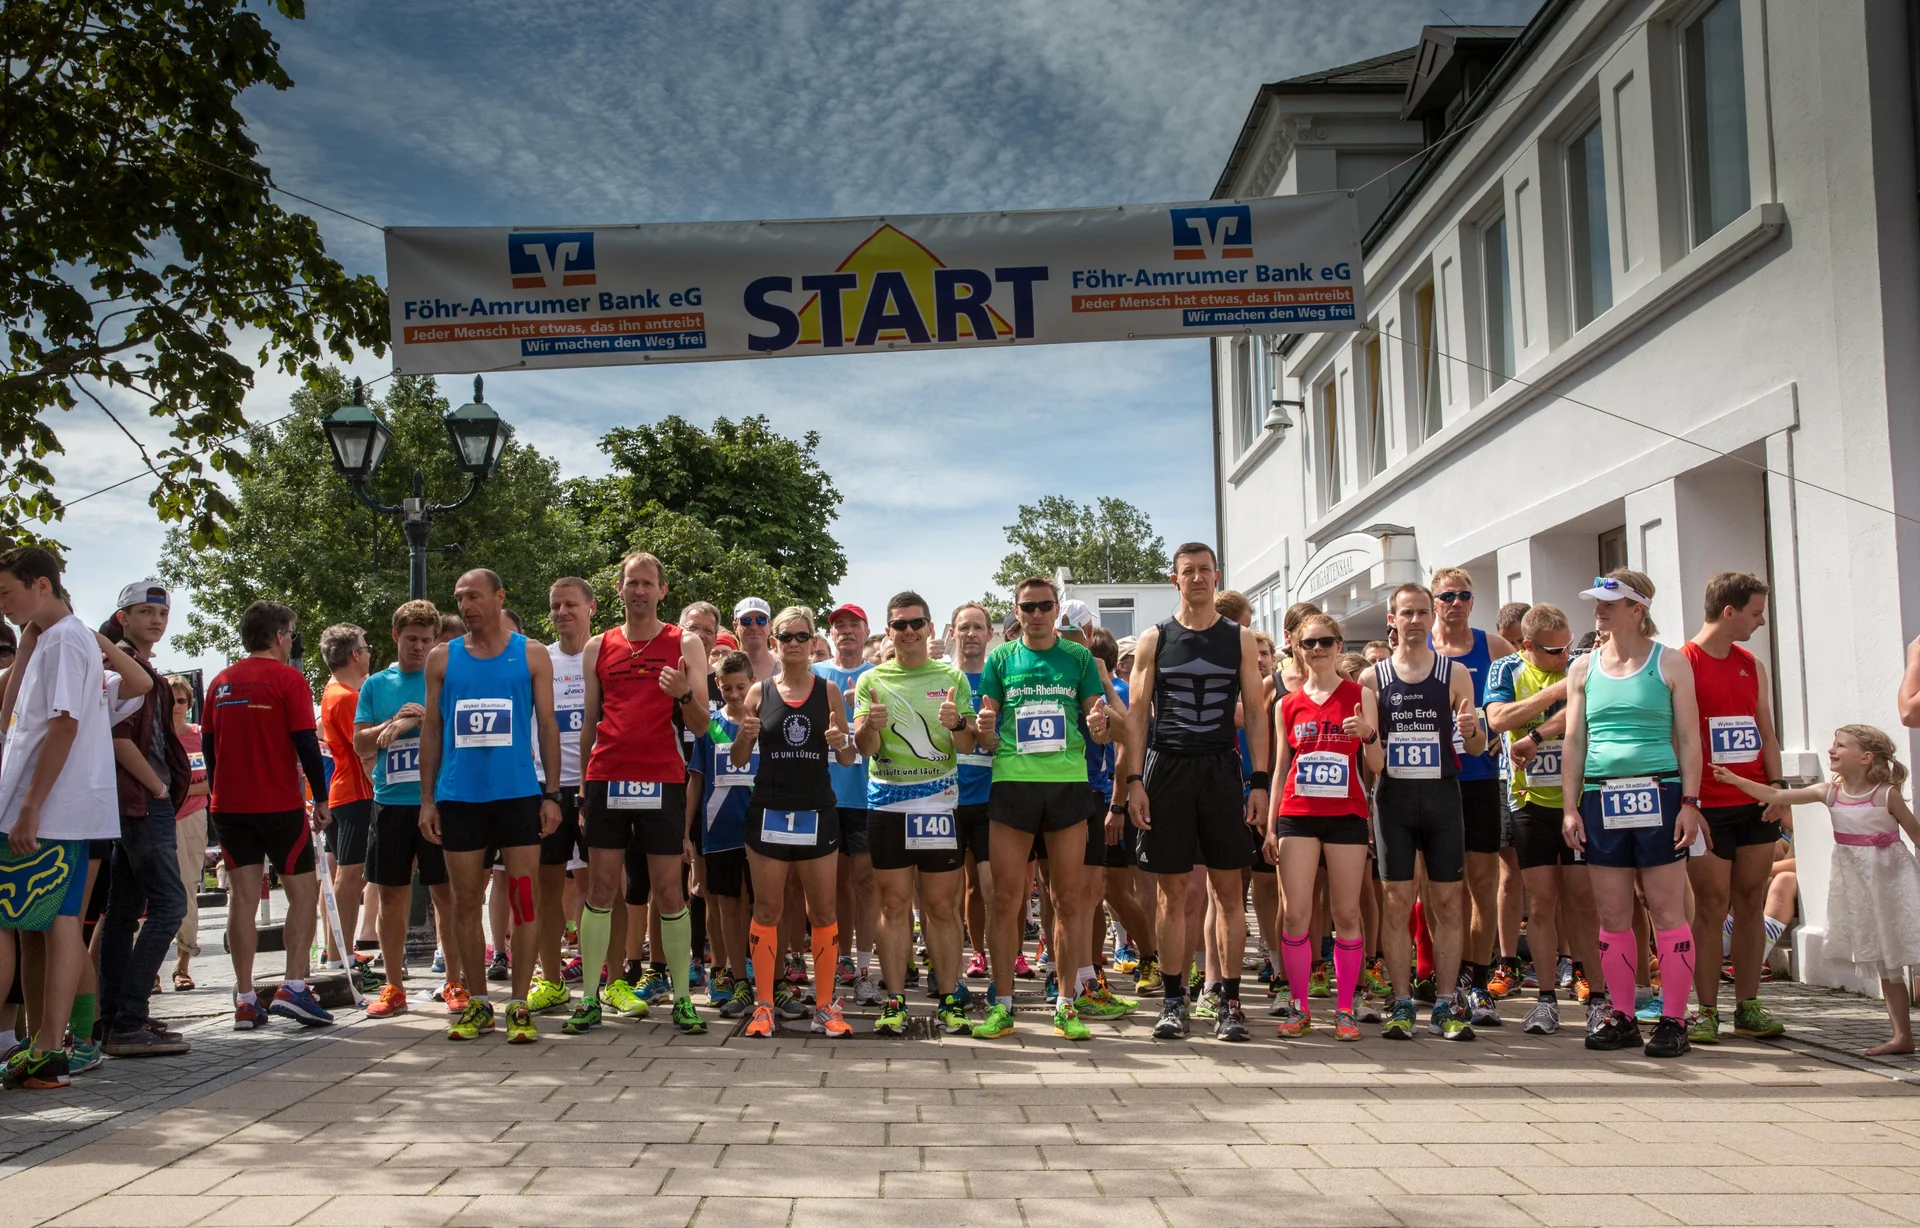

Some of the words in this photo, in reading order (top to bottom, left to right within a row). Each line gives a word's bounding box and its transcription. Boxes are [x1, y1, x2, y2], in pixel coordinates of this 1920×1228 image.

[1071, 268, 1249, 289] Föhr-Amrumer
[1255, 263, 1314, 283] Bank
[1320, 263, 1351, 281] eG
[404, 296, 591, 320] Föhr-Amrumer
[598, 288, 661, 311] Bank
[669, 287, 702, 307] eG
[743, 265, 1049, 352] START
[1080, 298, 1116, 309] Jeder
[1120, 294, 1171, 307] Mensch
[1174, 294, 1197, 306] hat
[1200, 294, 1243, 305] etwas,
[1247, 292, 1270, 303] das
[1273, 291, 1294, 303] ihn
[1298, 289, 1351, 301] antreibt
[1187, 310, 1210, 322] Wir
[1214, 308, 1266, 321] machen
[1269, 308, 1294, 319] den
[1297, 306, 1326, 320] Weg
[1329, 305, 1353, 317] frei
[412, 328, 450, 341] Jeder
[454, 324, 507, 338] Mensch
[512, 323, 536, 335] hat
[539, 323, 586, 334] etwas,
[590, 321, 615, 333] das
[618, 319, 642, 331] ihn
[645, 316, 702, 331] antreibt
[526, 339, 551, 352] Wir
[555, 337, 610, 350] machen
[614, 337, 641, 348] den
[645, 335, 675, 349] Weg
[679, 333, 704, 345] frei
[1310, 556, 1354, 593] KURGARTENSAAL
[469, 711, 498, 733] 97
[569, 711, 583, 730] 8
[1391, 711, 1413, 721] Rote
[1415, 708, 1437, 719] Erde
[1028, 718, 1055, 739] 49
[1294, 721, 1318, 740] BLS
[1396, 721, 1435, 732] Beckum
[404, 740, 420, 748] Stadtl
[1719, 729, 1757, 750] 125
[771, 751, 780, 759] LG
[780, 751, 795, 759] UNI
[795, 749, 820, 760] LÜBECK
[1395, 745, 1432, 765] 181
[902, 767, 918, 776] und
[1303, 764, 1343, 784] 169
[618, 781, 655, 796] 189
[1609, 791, 1653, 813] 138
[785, 812, 795, 831] 1
[913, 816, 951, 836] 140
